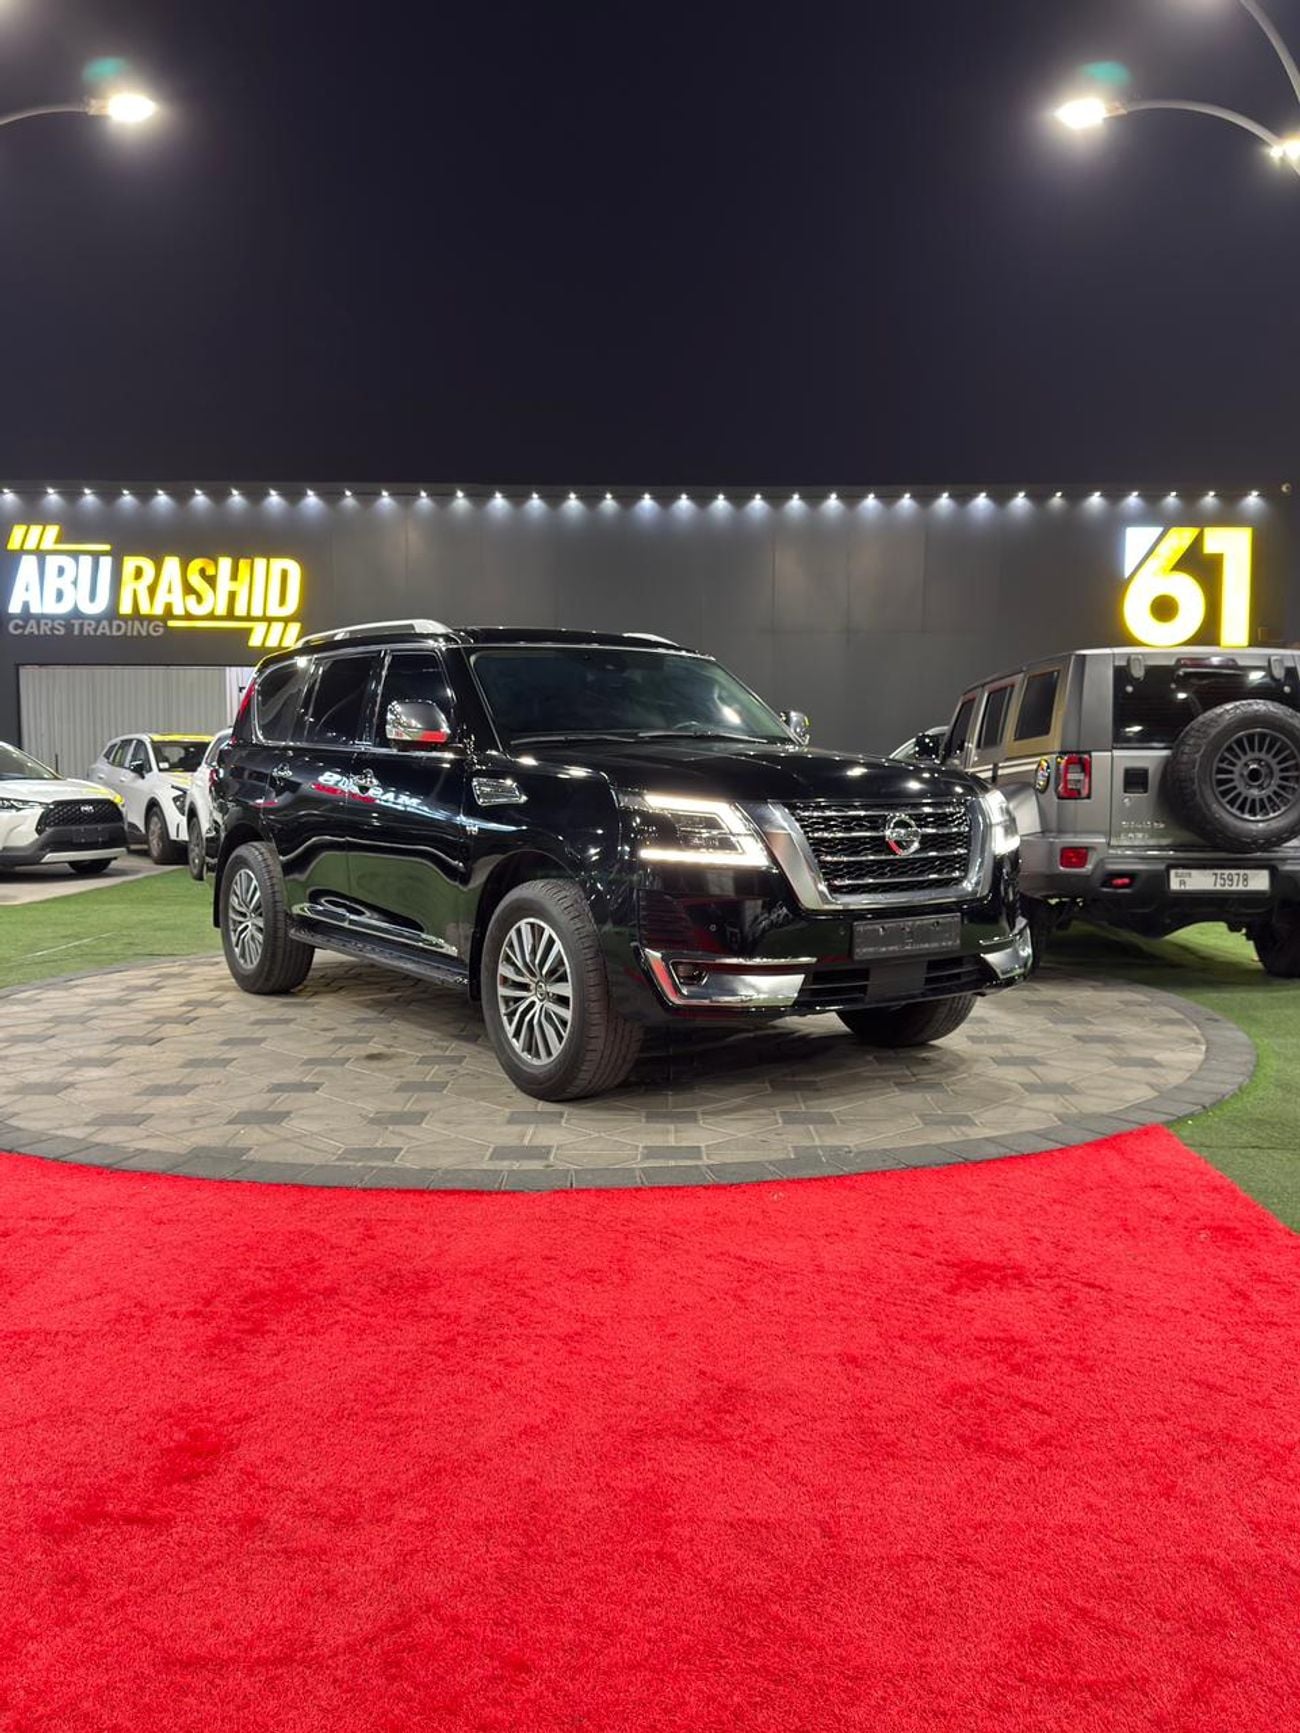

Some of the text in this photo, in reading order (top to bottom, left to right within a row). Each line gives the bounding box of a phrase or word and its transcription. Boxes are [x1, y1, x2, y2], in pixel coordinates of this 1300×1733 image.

[8, 554, 302, 617] ABU RASHID
[1122, 526, 1253, 648] 61
[7, 619, 165, 637] CARS TRADING
[1211, 872, 1249, 888] 75978
